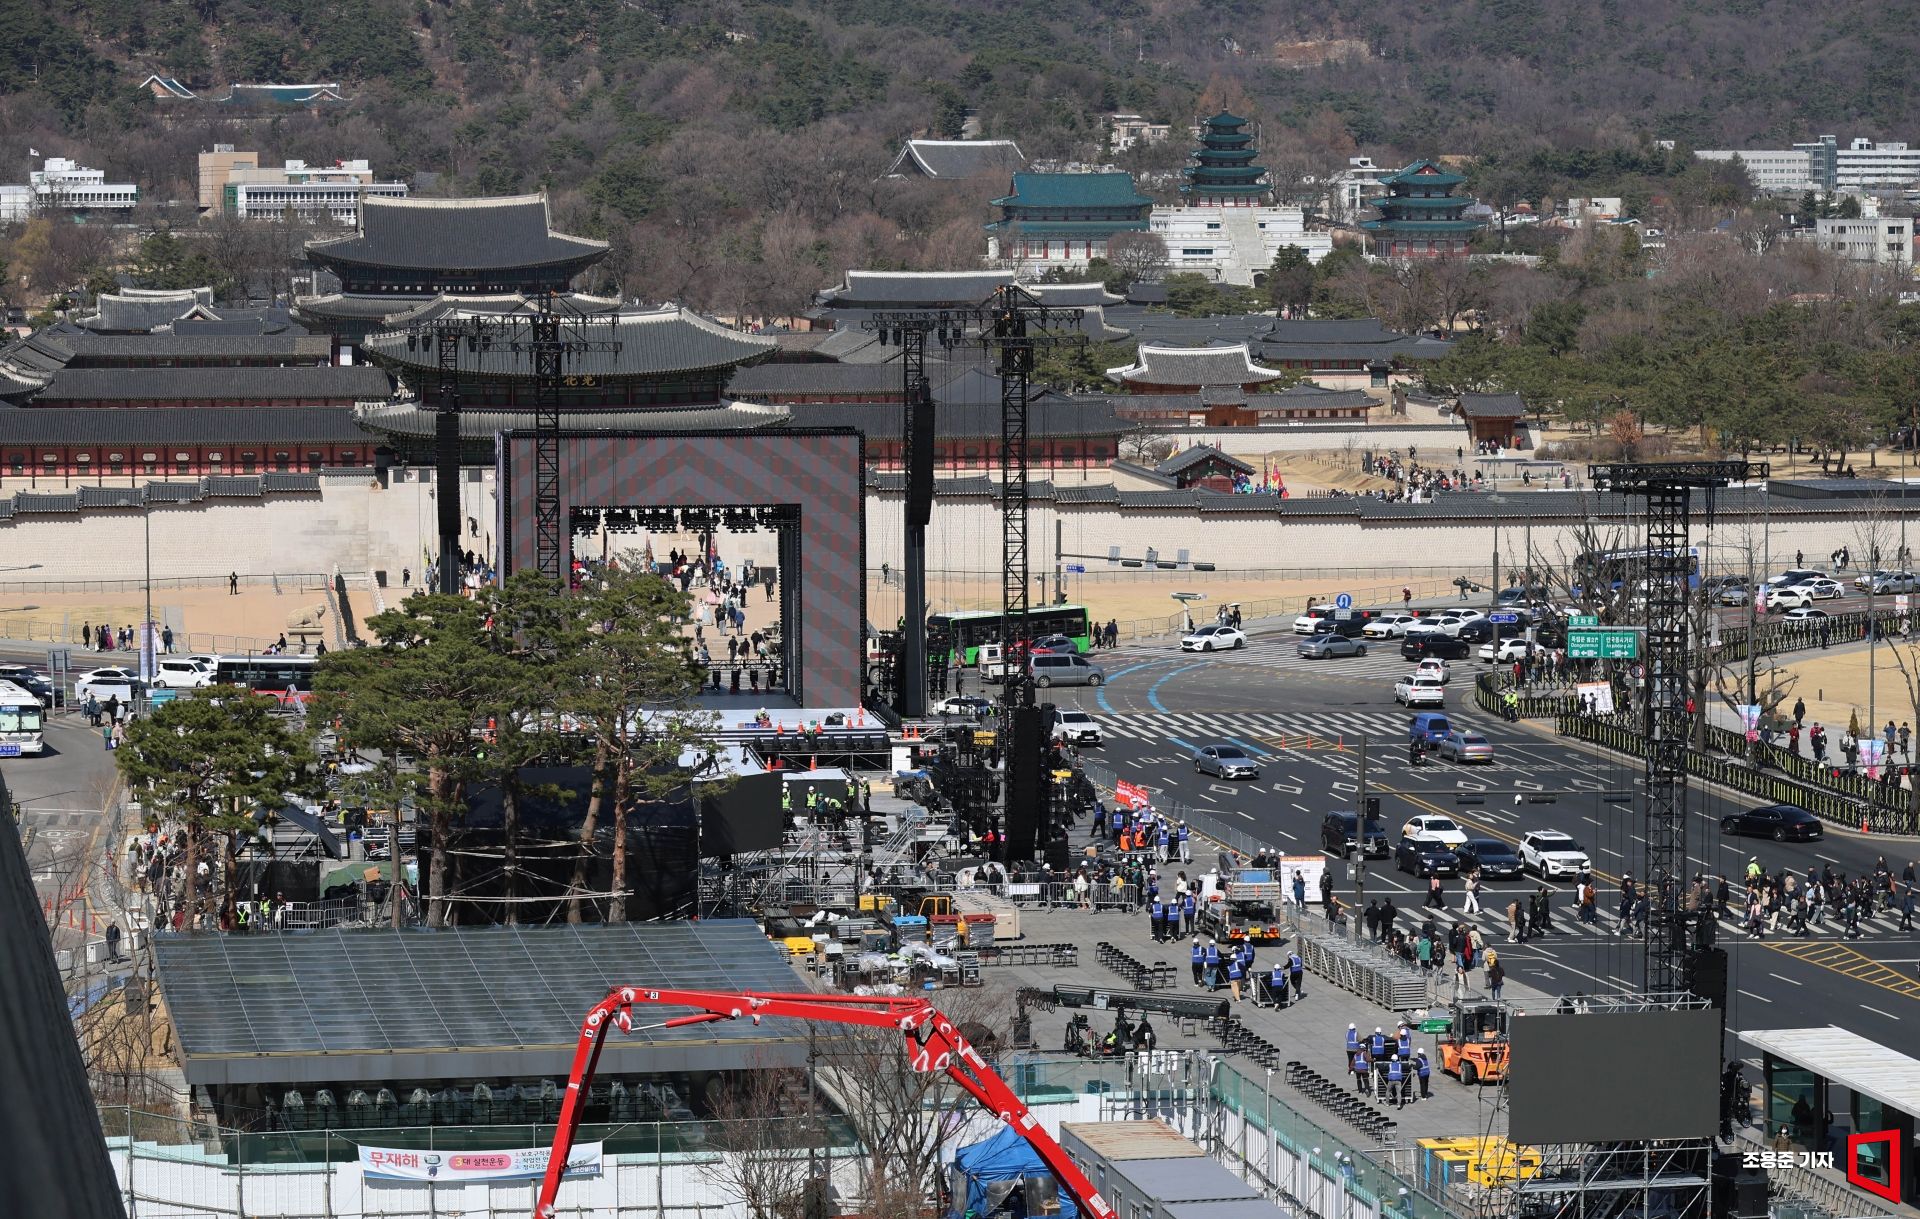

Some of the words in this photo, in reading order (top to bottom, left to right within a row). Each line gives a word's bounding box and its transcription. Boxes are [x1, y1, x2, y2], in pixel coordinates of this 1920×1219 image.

[371, 1151, 418, 1168] 무재해
[455, 1157, 470, 1167] 3대
[473, 1157, 505, 1167] 실천운동
